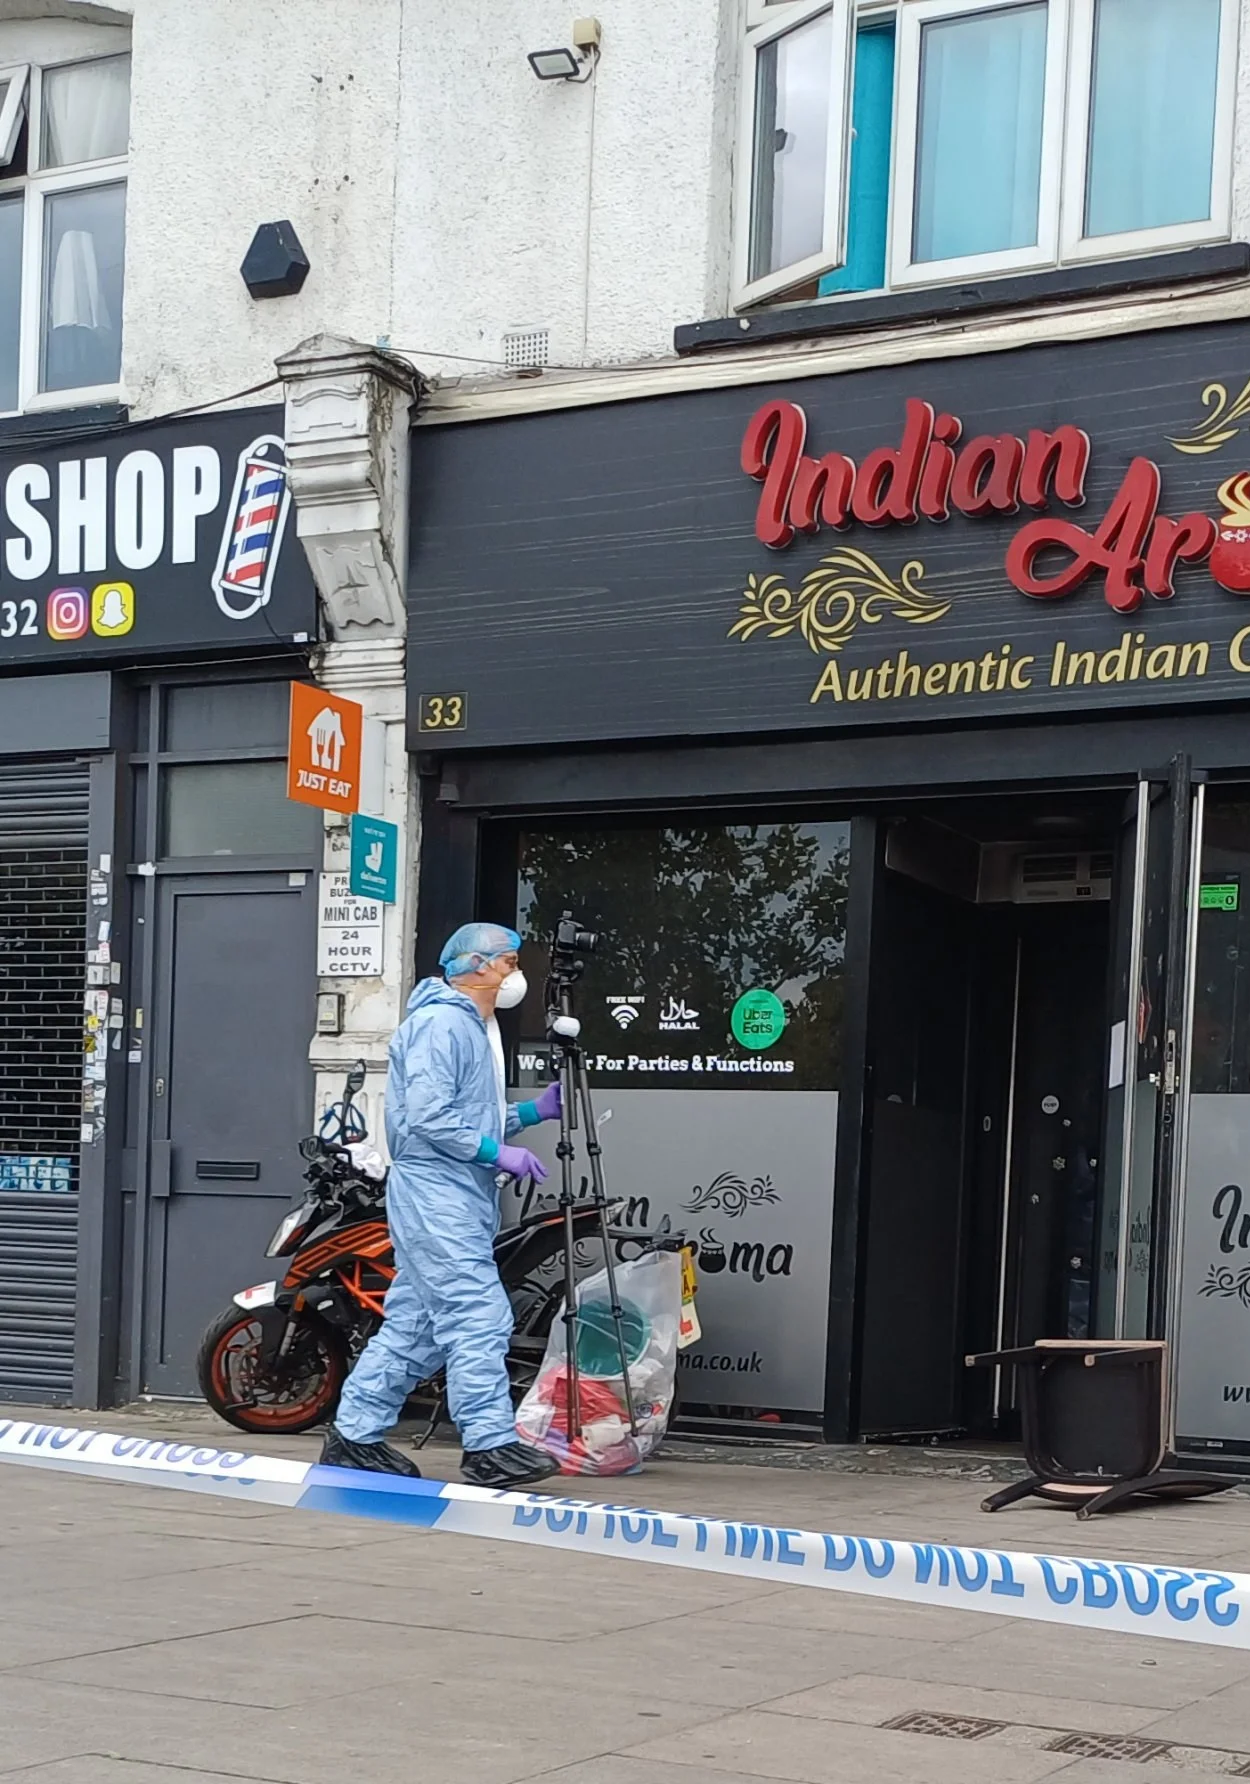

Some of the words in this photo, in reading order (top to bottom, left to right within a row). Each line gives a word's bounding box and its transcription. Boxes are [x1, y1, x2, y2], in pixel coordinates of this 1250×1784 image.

[741, 399, 1089, 549] Indian
[5, 445, 221, 581] SHOP
[0, 599, 38, 637] 32
[810, 644, 1033, 703] Authentic
[1050, 633, 1210, 687] Indian
[425, 696, 462, 727] 33
[297, 769, 327, 793] JUST
[328, 779, 352, 798] EAT
[334, 876, 348, 886] PR
[324, 907, 350, 921] MINI
[354, 906, 377, 921] CAB
[341, 931, 359, 940] 24
[328, 947, 372, 956] HOUR
[329, 963, 370, 972] CCTV
[743, 1008, 773, 1020] Uber
[658, 1021, 700, 1030] HALAL
[743, 1022, 772, 1034] Eats
[517, 1054, 545, 1071] We
[595, 1055, 625, 1071] For
[627, 1055, 689, 1072] Parties
[691, 1056, 704, 1072] &
[705, 1055, 795, 1073] Functions
